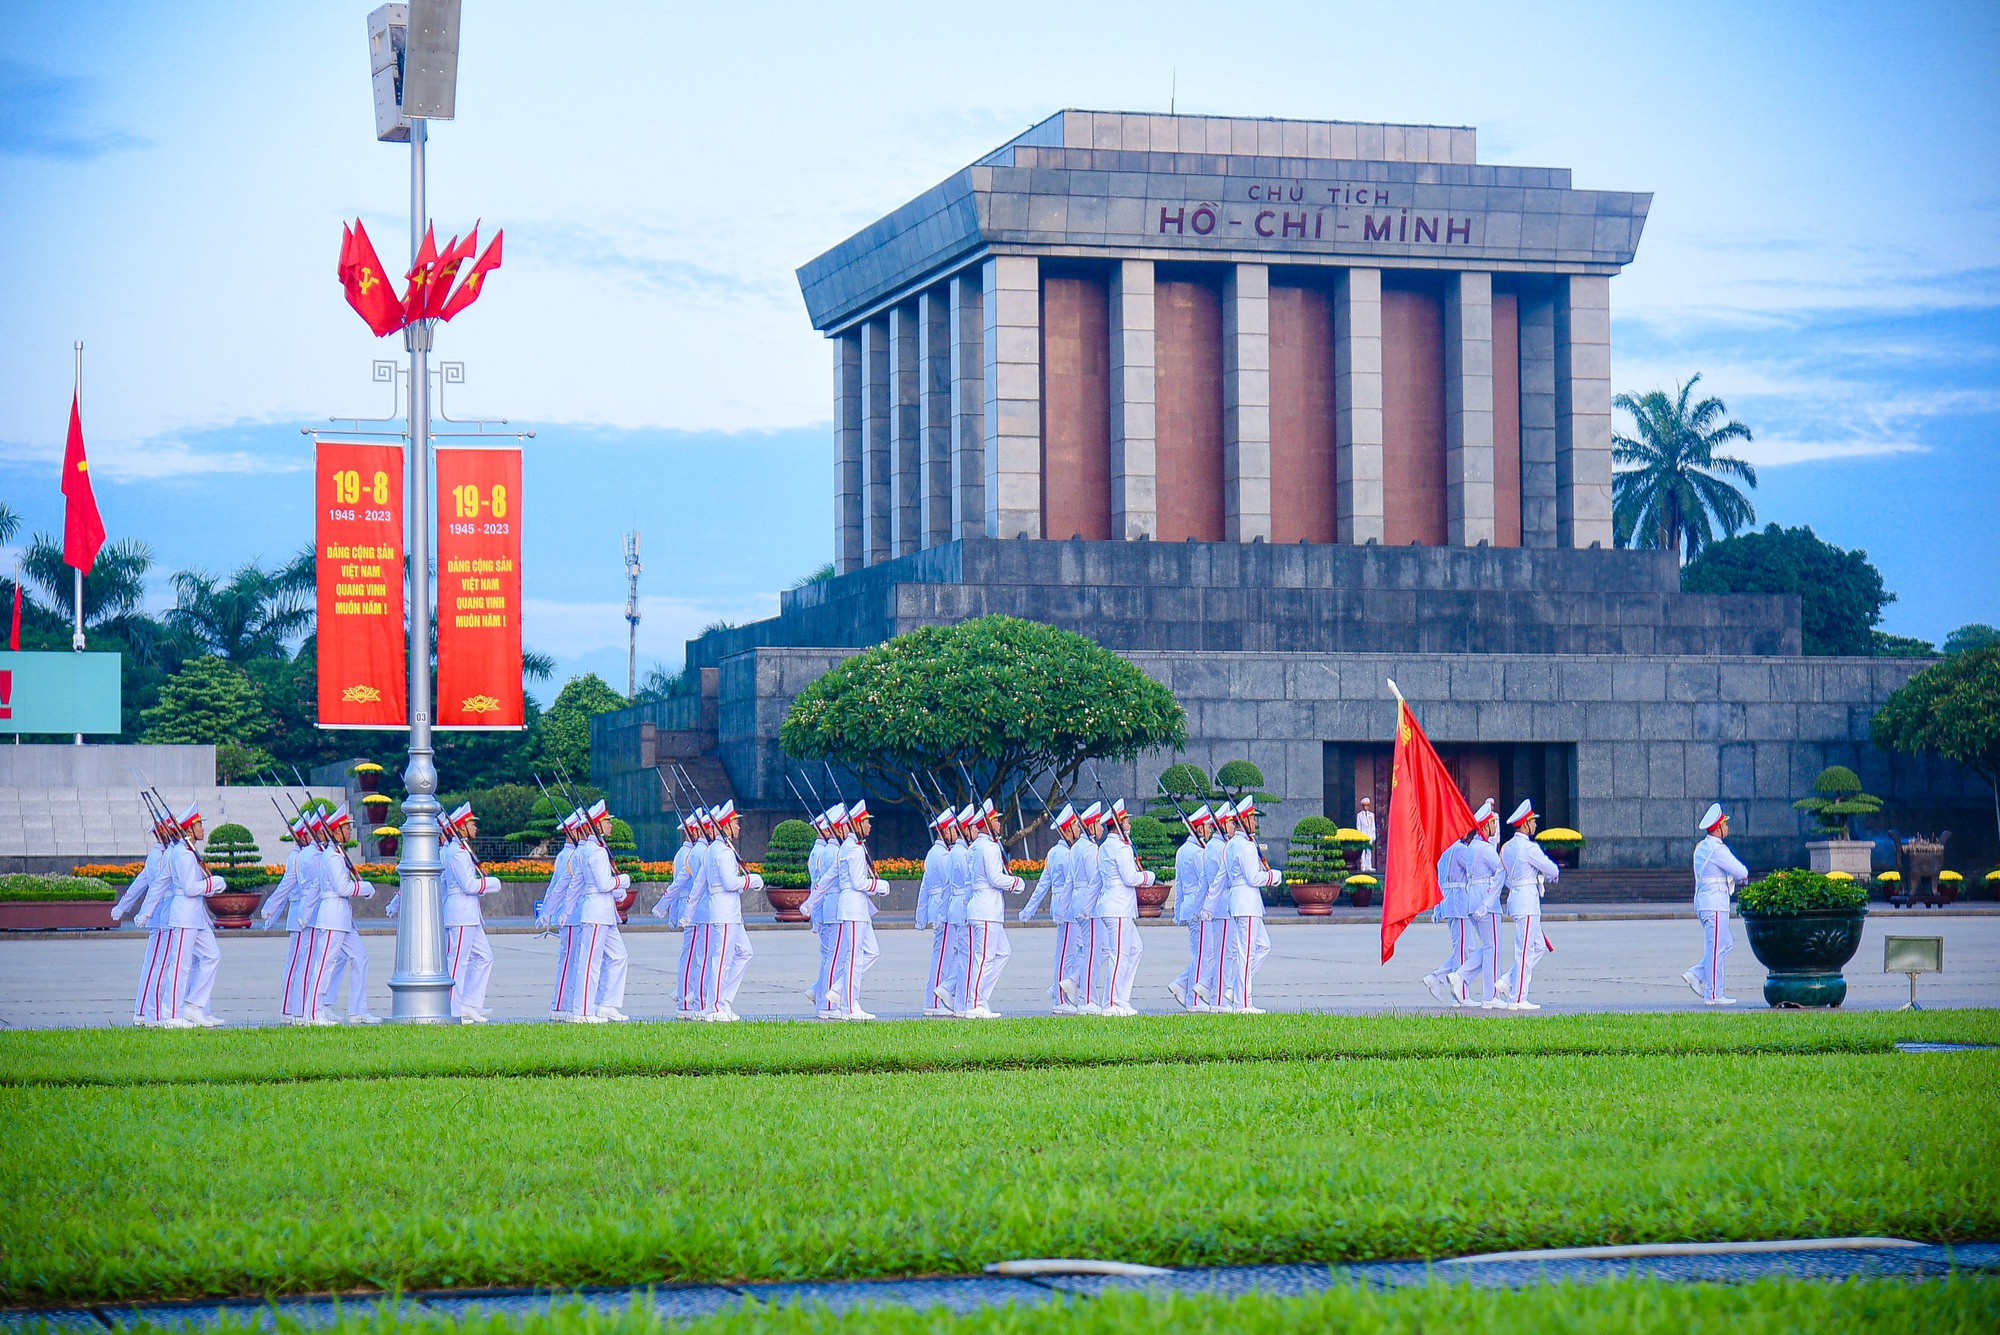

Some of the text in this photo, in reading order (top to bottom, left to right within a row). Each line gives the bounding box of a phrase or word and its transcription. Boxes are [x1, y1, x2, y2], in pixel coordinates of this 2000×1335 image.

[1248, 179, 1389, 210] CHỦ TỊCH
[1160, 202, 1219, 235] HỒ
[1255, 206, 1326, 238] CHÍ
[333, 470, 388, 504] 19-8
[452, 484, 506, 518] 19-8
[329, 510, 355, 521] 1945
[365, 510, 391, 521] 2023
[450, 524, 474, 534] 1945
[484, 524, 509, 534] 2023
[327, 542, 394, 561] ĐẢNG CỘNG SẢN
[341, 563, 380, 579] VIỆT NAM
[448, 555, 512, 574] ĐẢNG CỘNG SẢN
[336, 584, 386, 596] QUANG VINH
[462, 577, 499, 593] VIỆT NAM
[335, 600, 360, 614] MUÔN
[362, 601, 382, 614] NĂM
[456, 597, 504, 610] QUANG VINH
[456, 614, 480, 628] MUÔN
[482, 614, 501, 627] NĂM
[416, 713, 426, 722] 03
